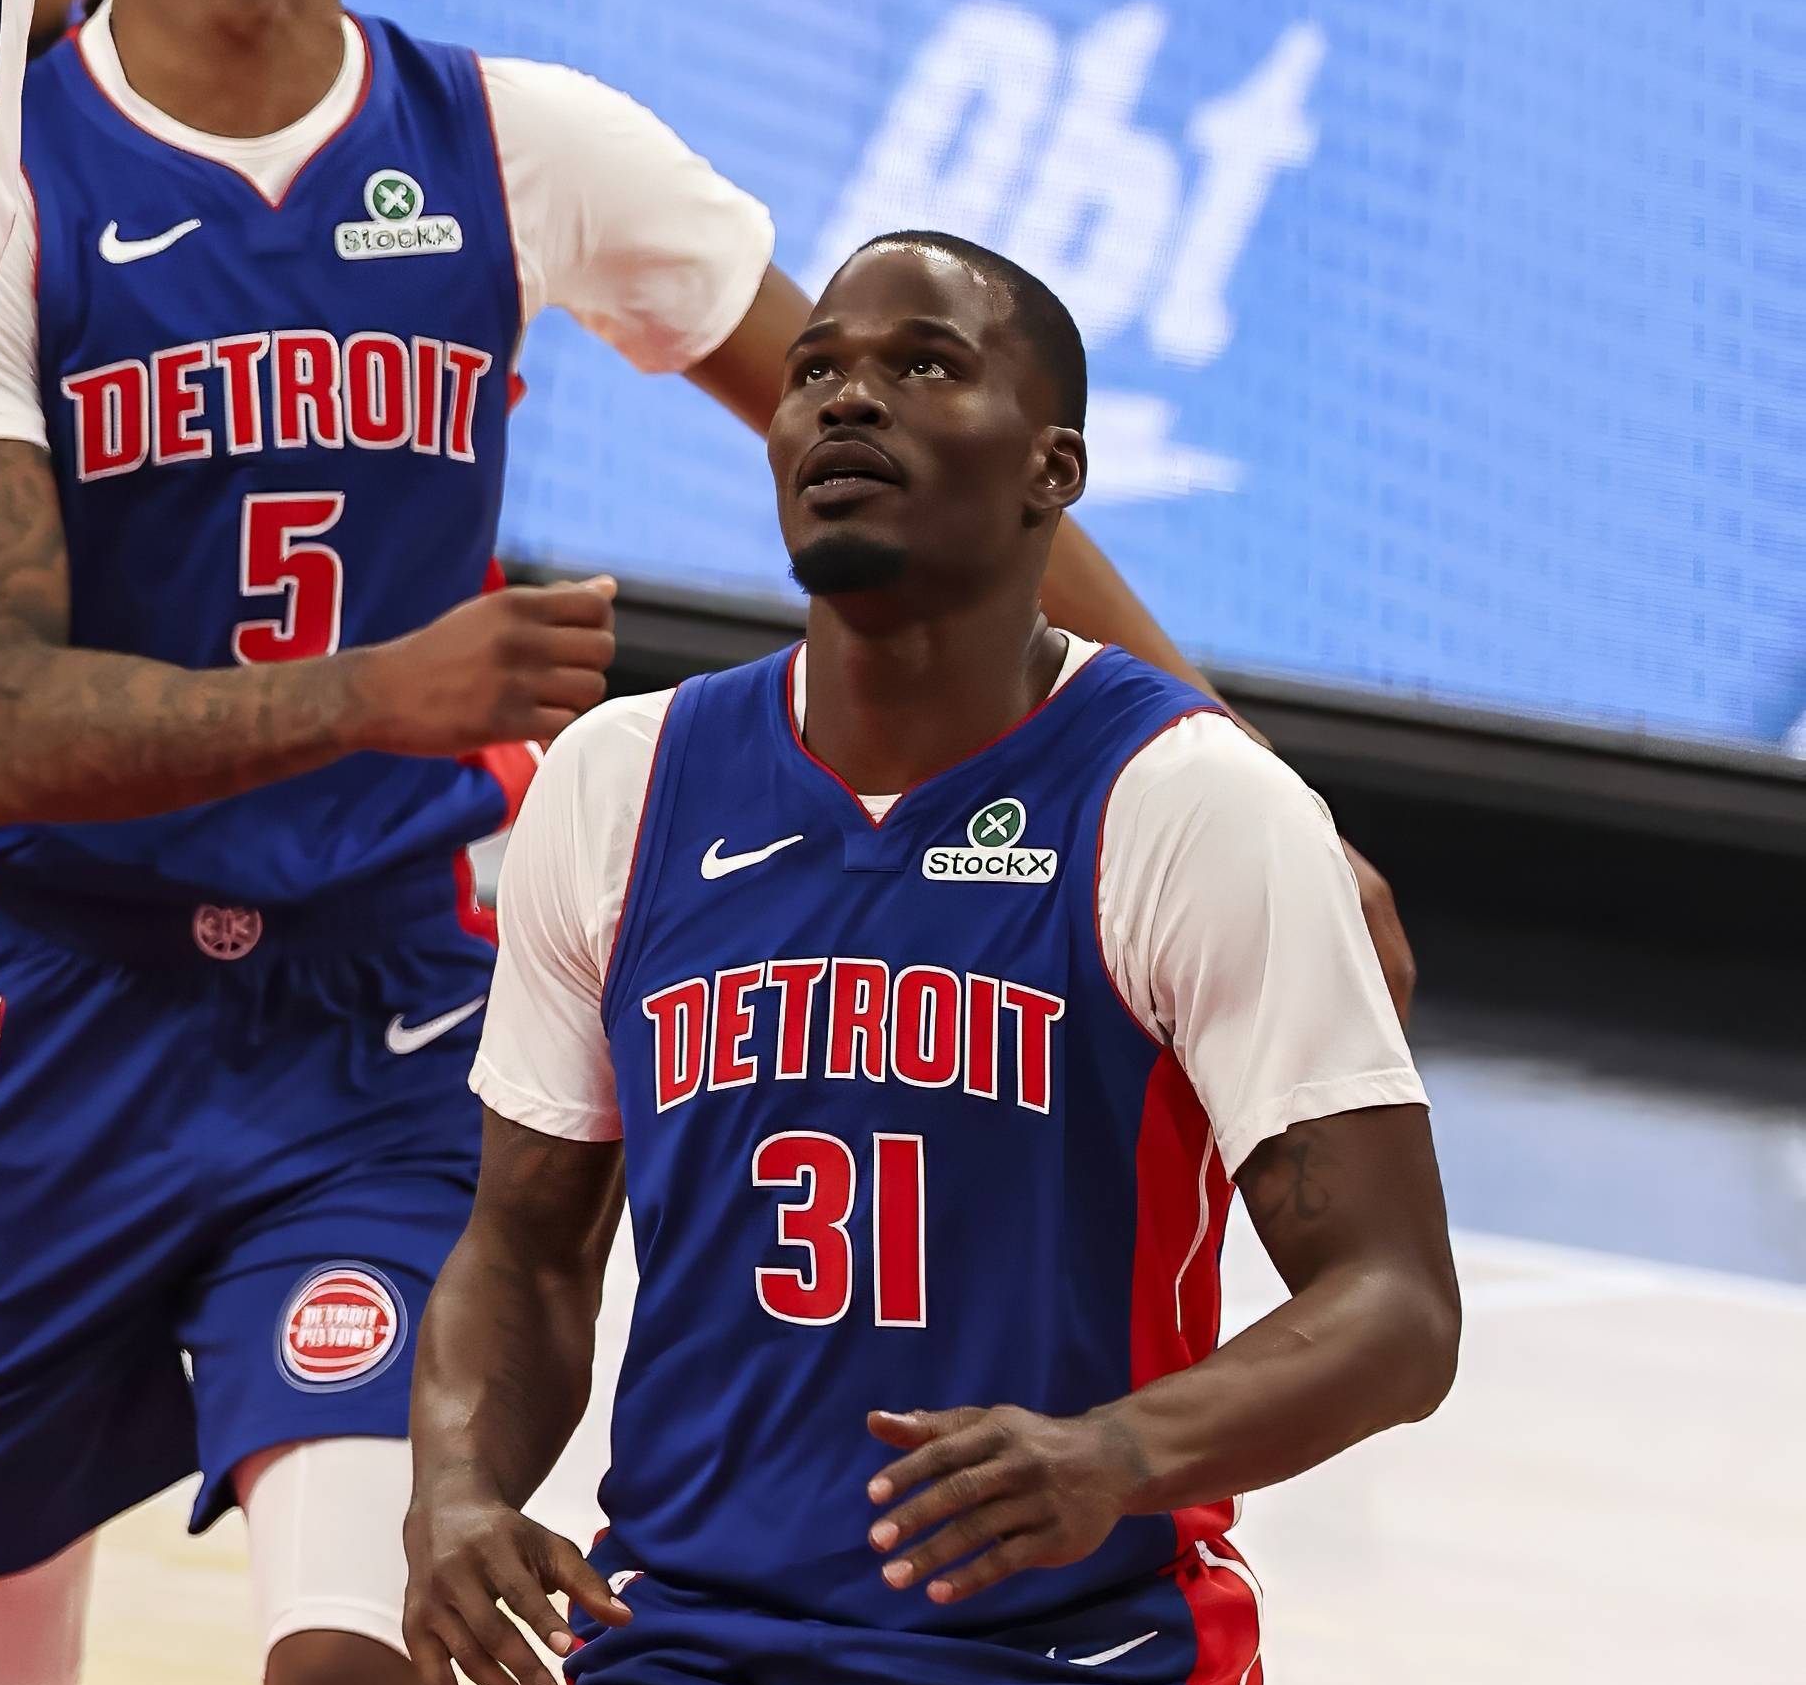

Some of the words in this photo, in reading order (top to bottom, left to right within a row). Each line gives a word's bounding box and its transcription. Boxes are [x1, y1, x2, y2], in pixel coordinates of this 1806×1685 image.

[60, 328, 493, 483] DETROIT
[231, 490, 346, 666] 5
[928, 852, 1053, 876] StockX
[642, 957, 1065, 1115] DETROIT
[752, 1130, 927, 1329] 31
